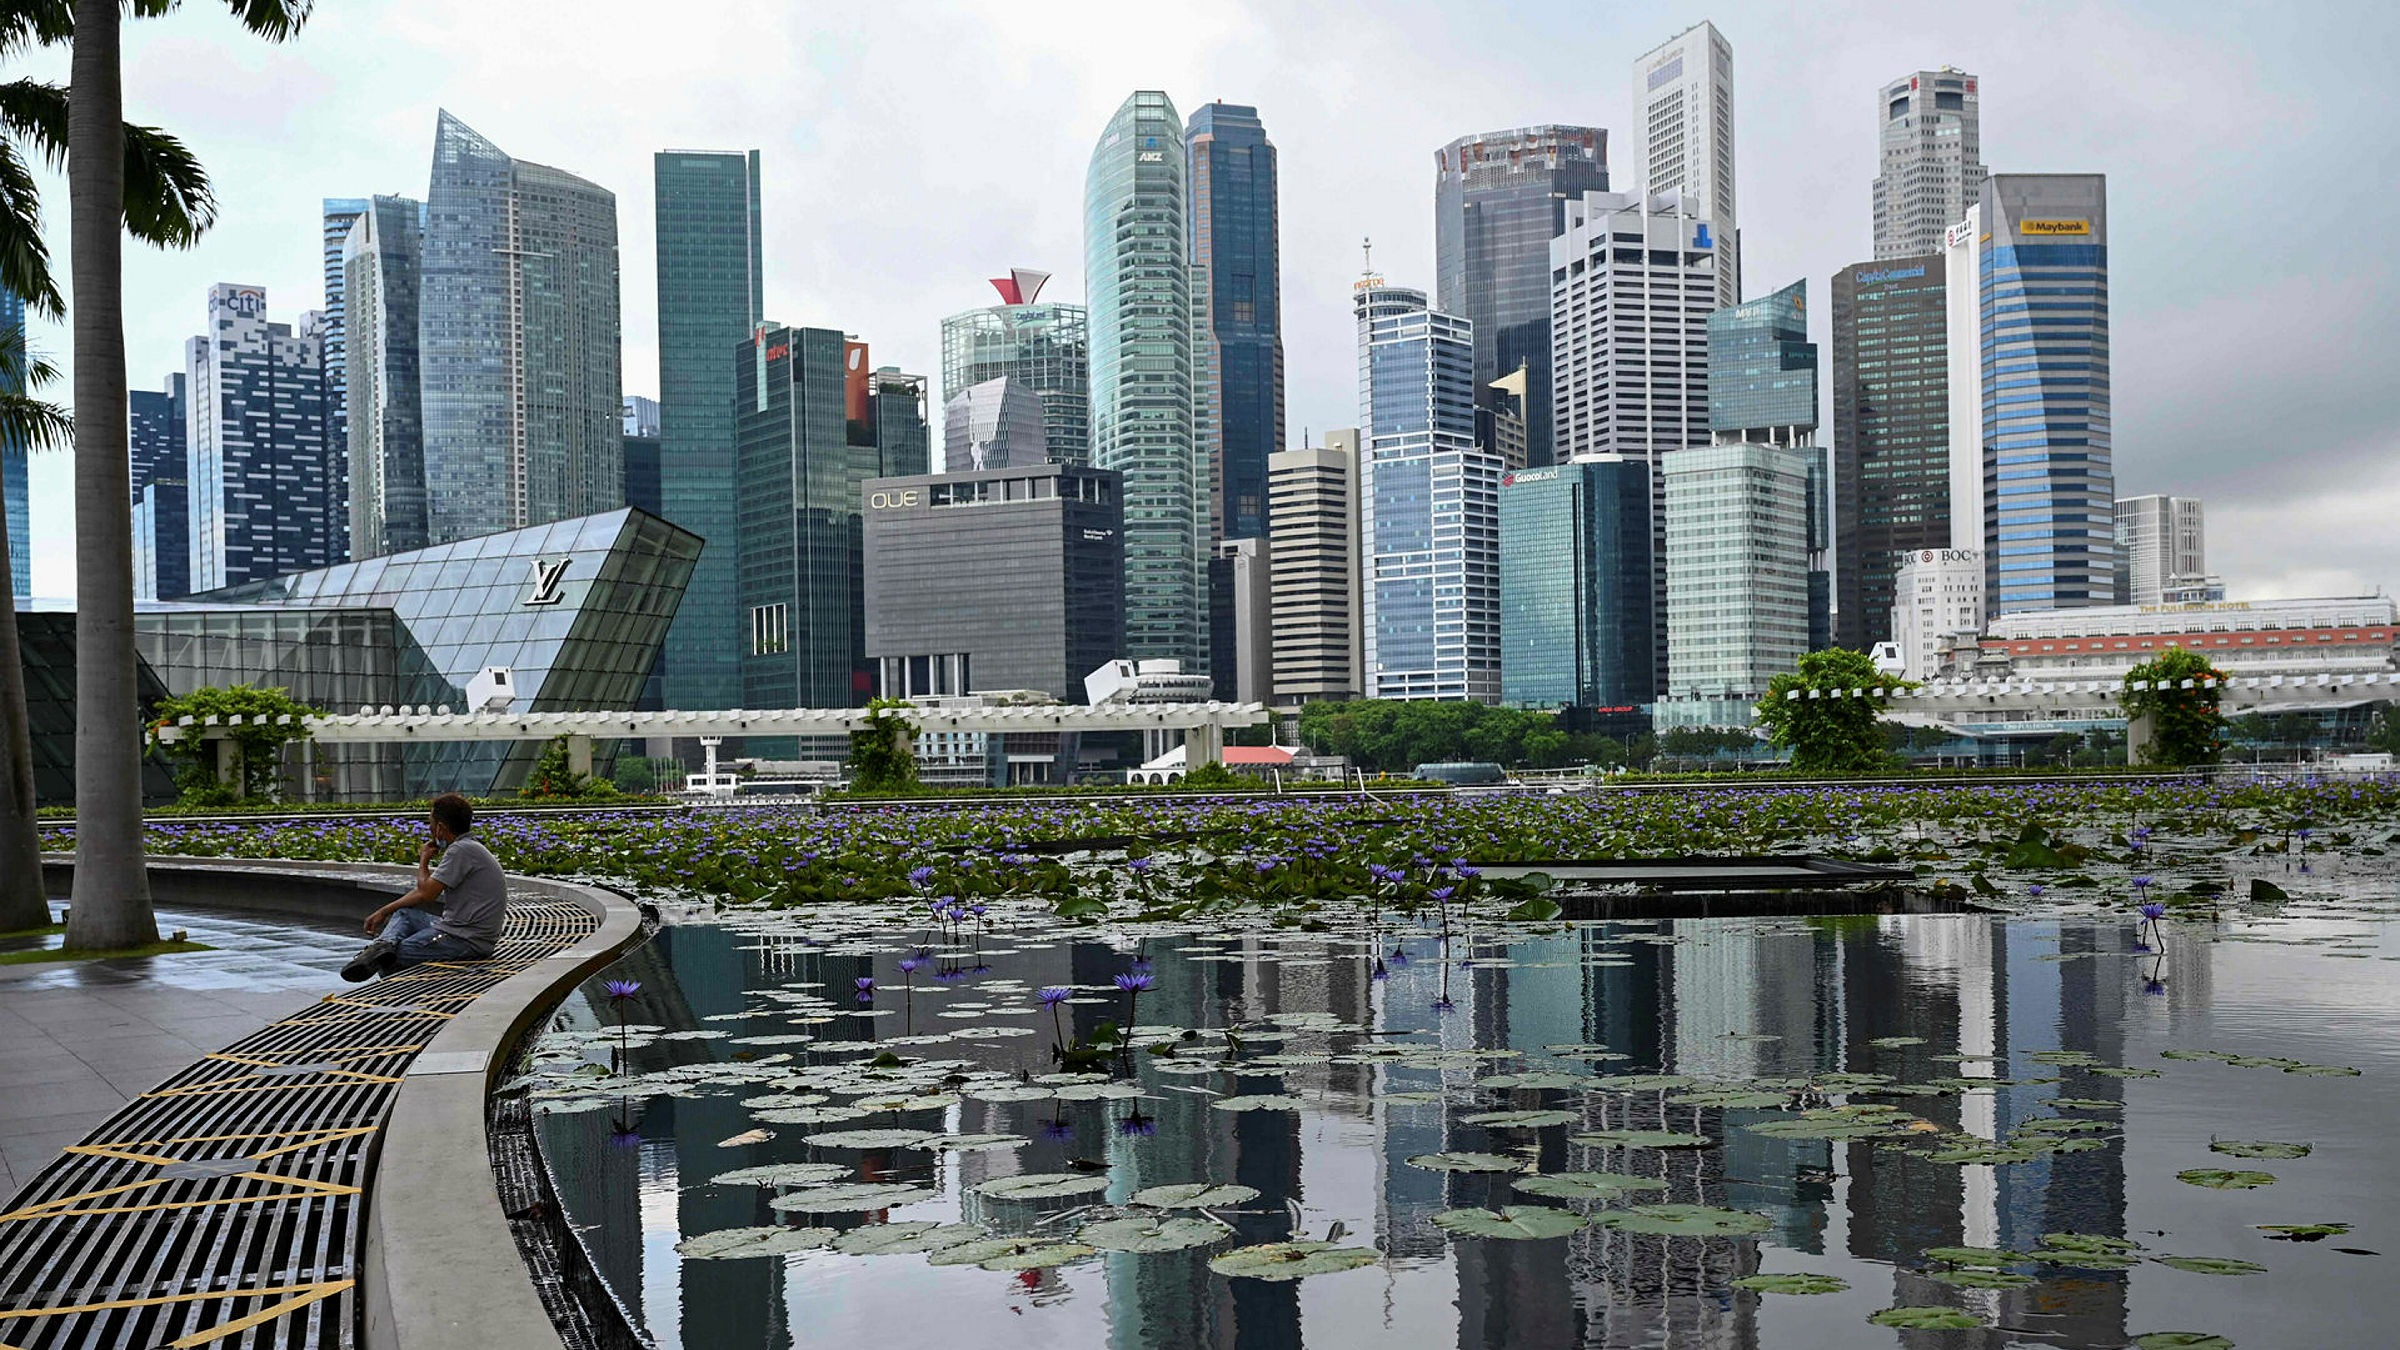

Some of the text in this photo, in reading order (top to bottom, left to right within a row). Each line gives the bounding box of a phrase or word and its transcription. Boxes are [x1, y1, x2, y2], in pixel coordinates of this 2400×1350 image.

[1138, 152, 1163, 162] ANZ
[2035, 222, 2082, 233] Maybank
[227, 292, 260, 313] citi
[1515, 465, 1558, 483] GuocoLand
[871, 490, 919, 509] OUE
[1941, 550, 1972, 562] BOC
[2161, 603, 2215, 612] FULLERTON
[2218, 602, 2251, 610] HOTEL
